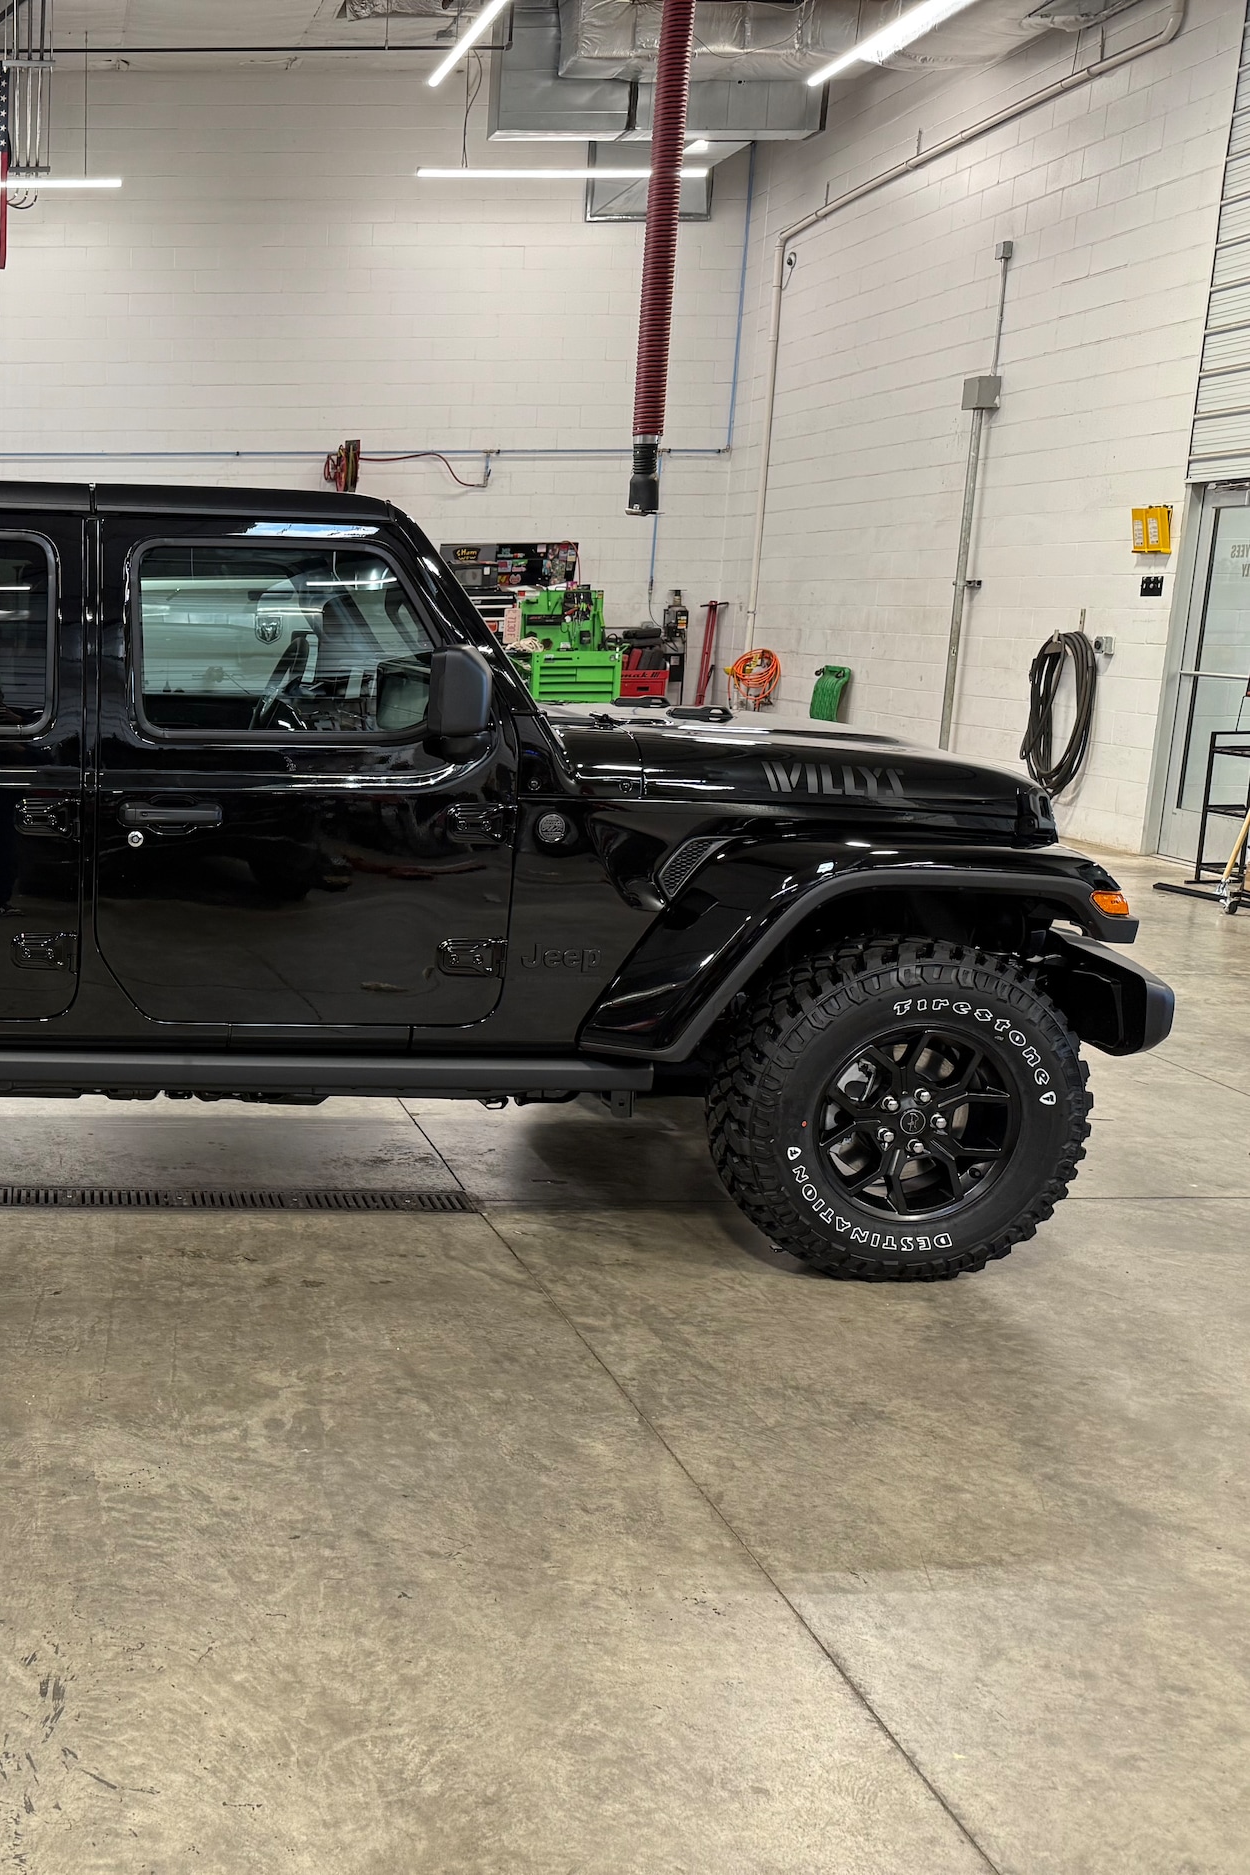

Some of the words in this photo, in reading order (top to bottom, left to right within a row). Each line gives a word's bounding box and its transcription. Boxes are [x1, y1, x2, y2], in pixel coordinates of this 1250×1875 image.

[761, 761, 905, 797] WILLYS
[521, 943, 602, 973] Jeep
[893, 998, 1053, 1087] Firestone
[791, 1166, 953, 1252] DESTINATION
